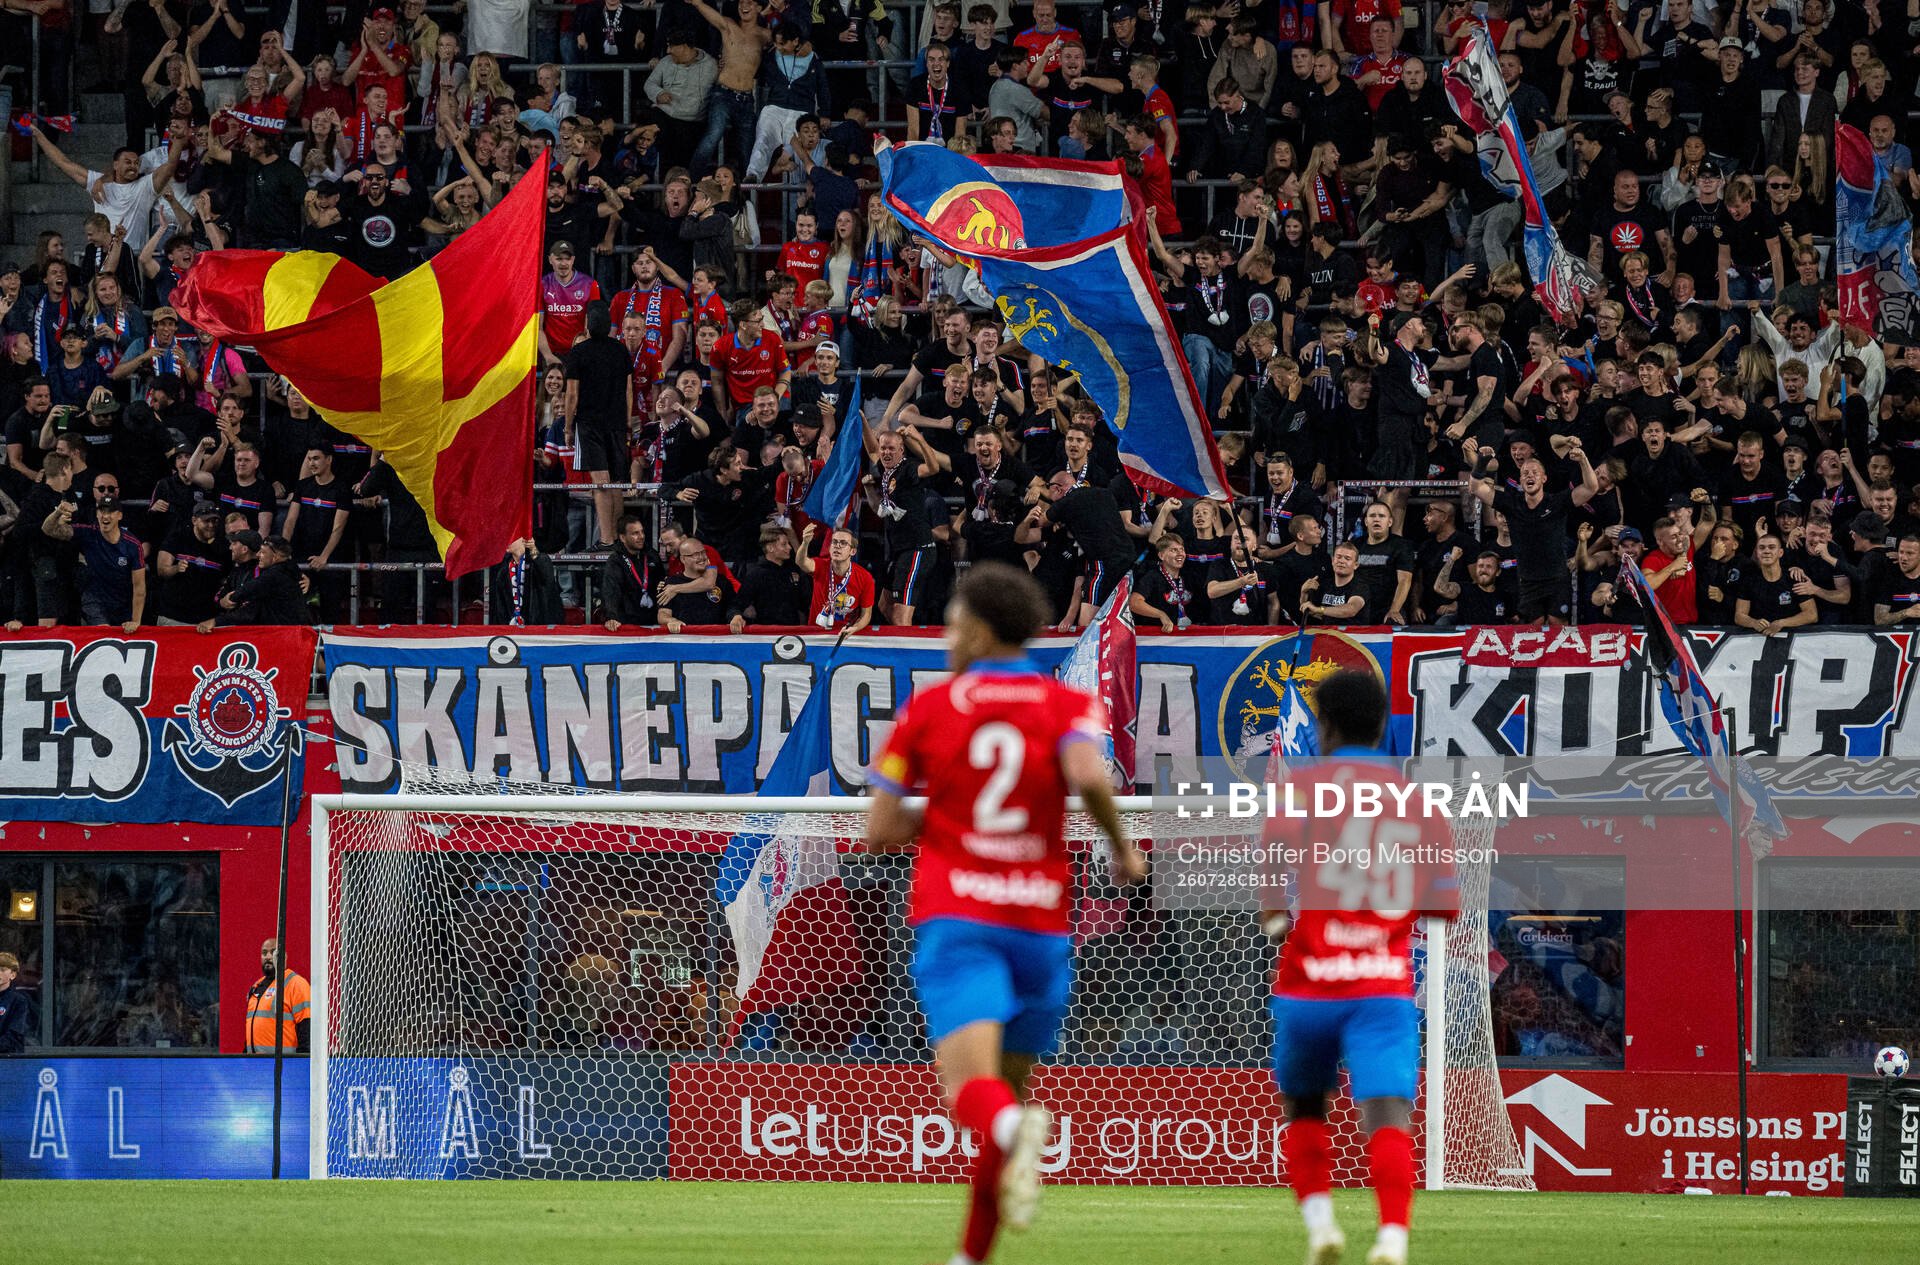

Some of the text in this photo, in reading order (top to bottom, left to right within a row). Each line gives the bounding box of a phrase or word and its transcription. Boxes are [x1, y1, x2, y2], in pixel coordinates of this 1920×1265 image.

[548, 303, 572, 313] akea
[1465, 626, 1630, 664] ACAB
[204, 677, 263, 703] CREWMATES
[0, 640, 155, 800] ES
[201, 718, 263, 746] HELSINGBORG
[328, 633, 1204, 796] SKÅNEPÅGA
[968, 720, 1029, 833] 2
[1316, 817, 1421, 920] 45
[1517, 927, 1574, 946] Carlsberg
[1625, 1107, 1803, 1140] Jönssons
[1856, 1101, 1873, 1184] SELECT
[1899, 1103, 1920, 1185] SELECT
[1662, 1150, 1674, 1180] i
